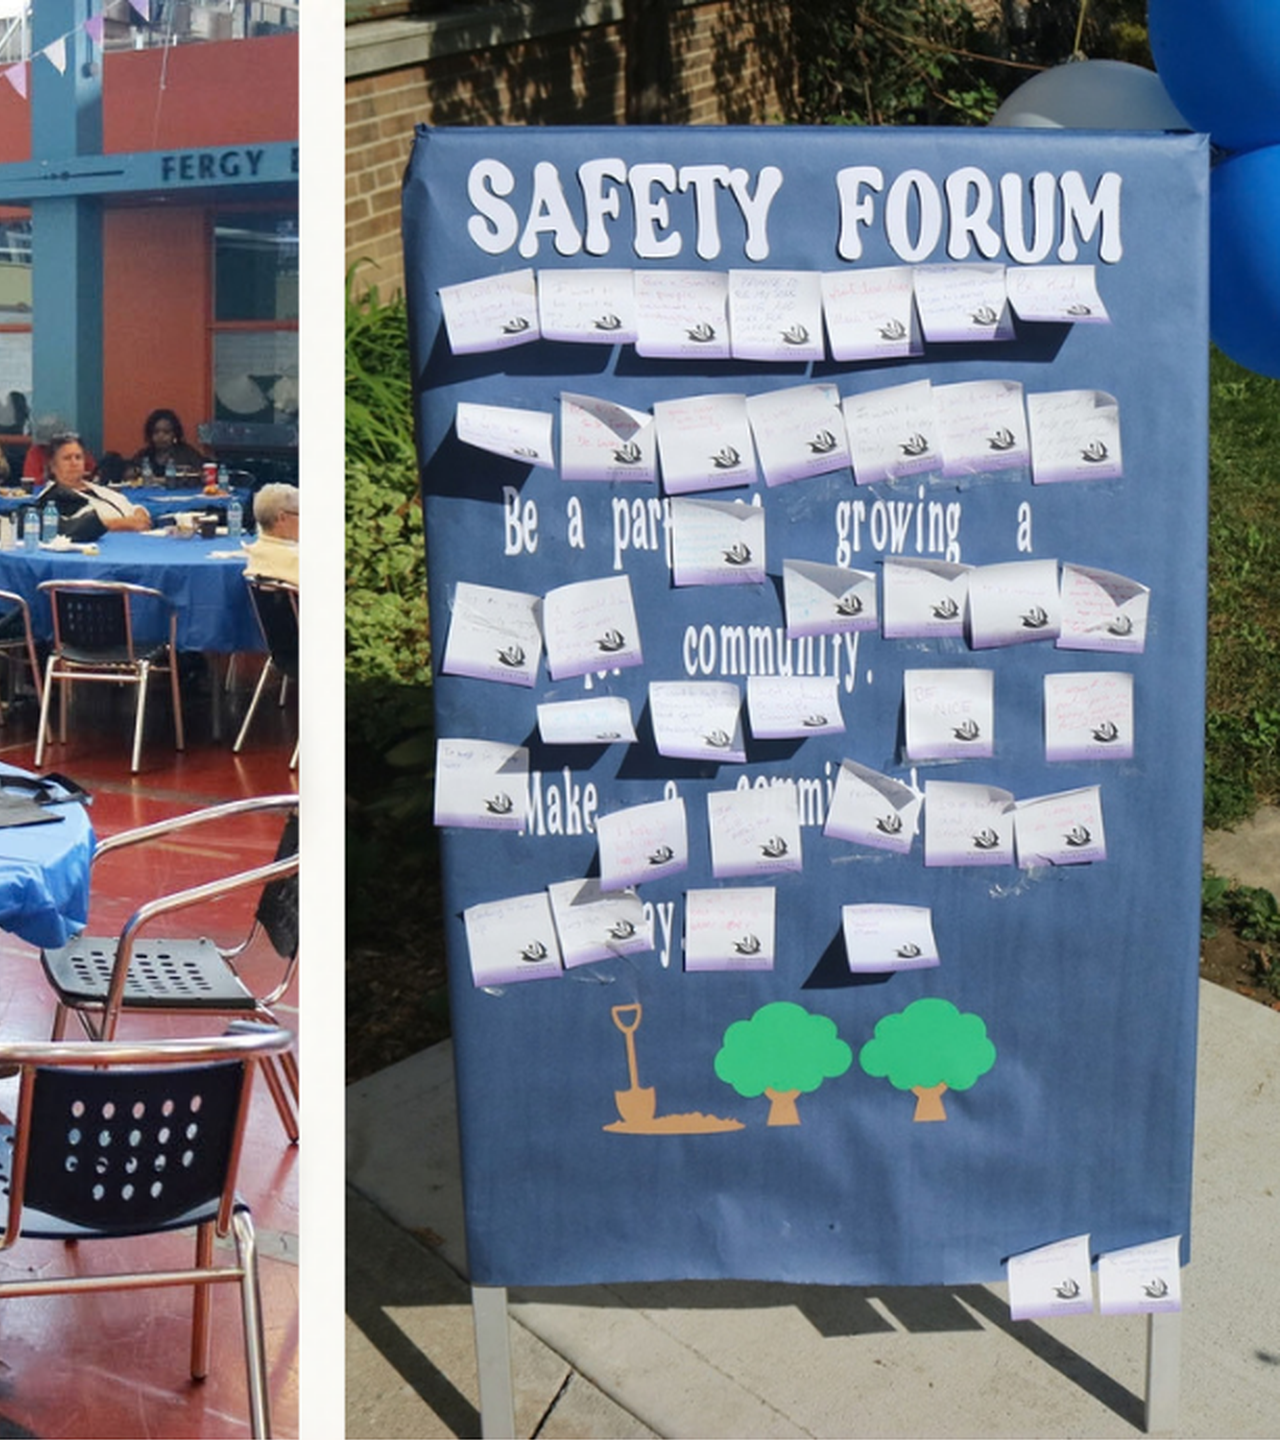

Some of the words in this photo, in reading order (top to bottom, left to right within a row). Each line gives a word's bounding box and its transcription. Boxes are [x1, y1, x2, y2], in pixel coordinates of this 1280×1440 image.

[161, 149, 265, 182] FERGY
[466, 157, 783, 261] SAFETY
[836, 166, 1123, 263] FORUM
[502, 485, 538, 555] Be
[567, 495, 585, 549] a
[836, 484, 962, 568] growing
[1017, 501, 1033, 553] a
